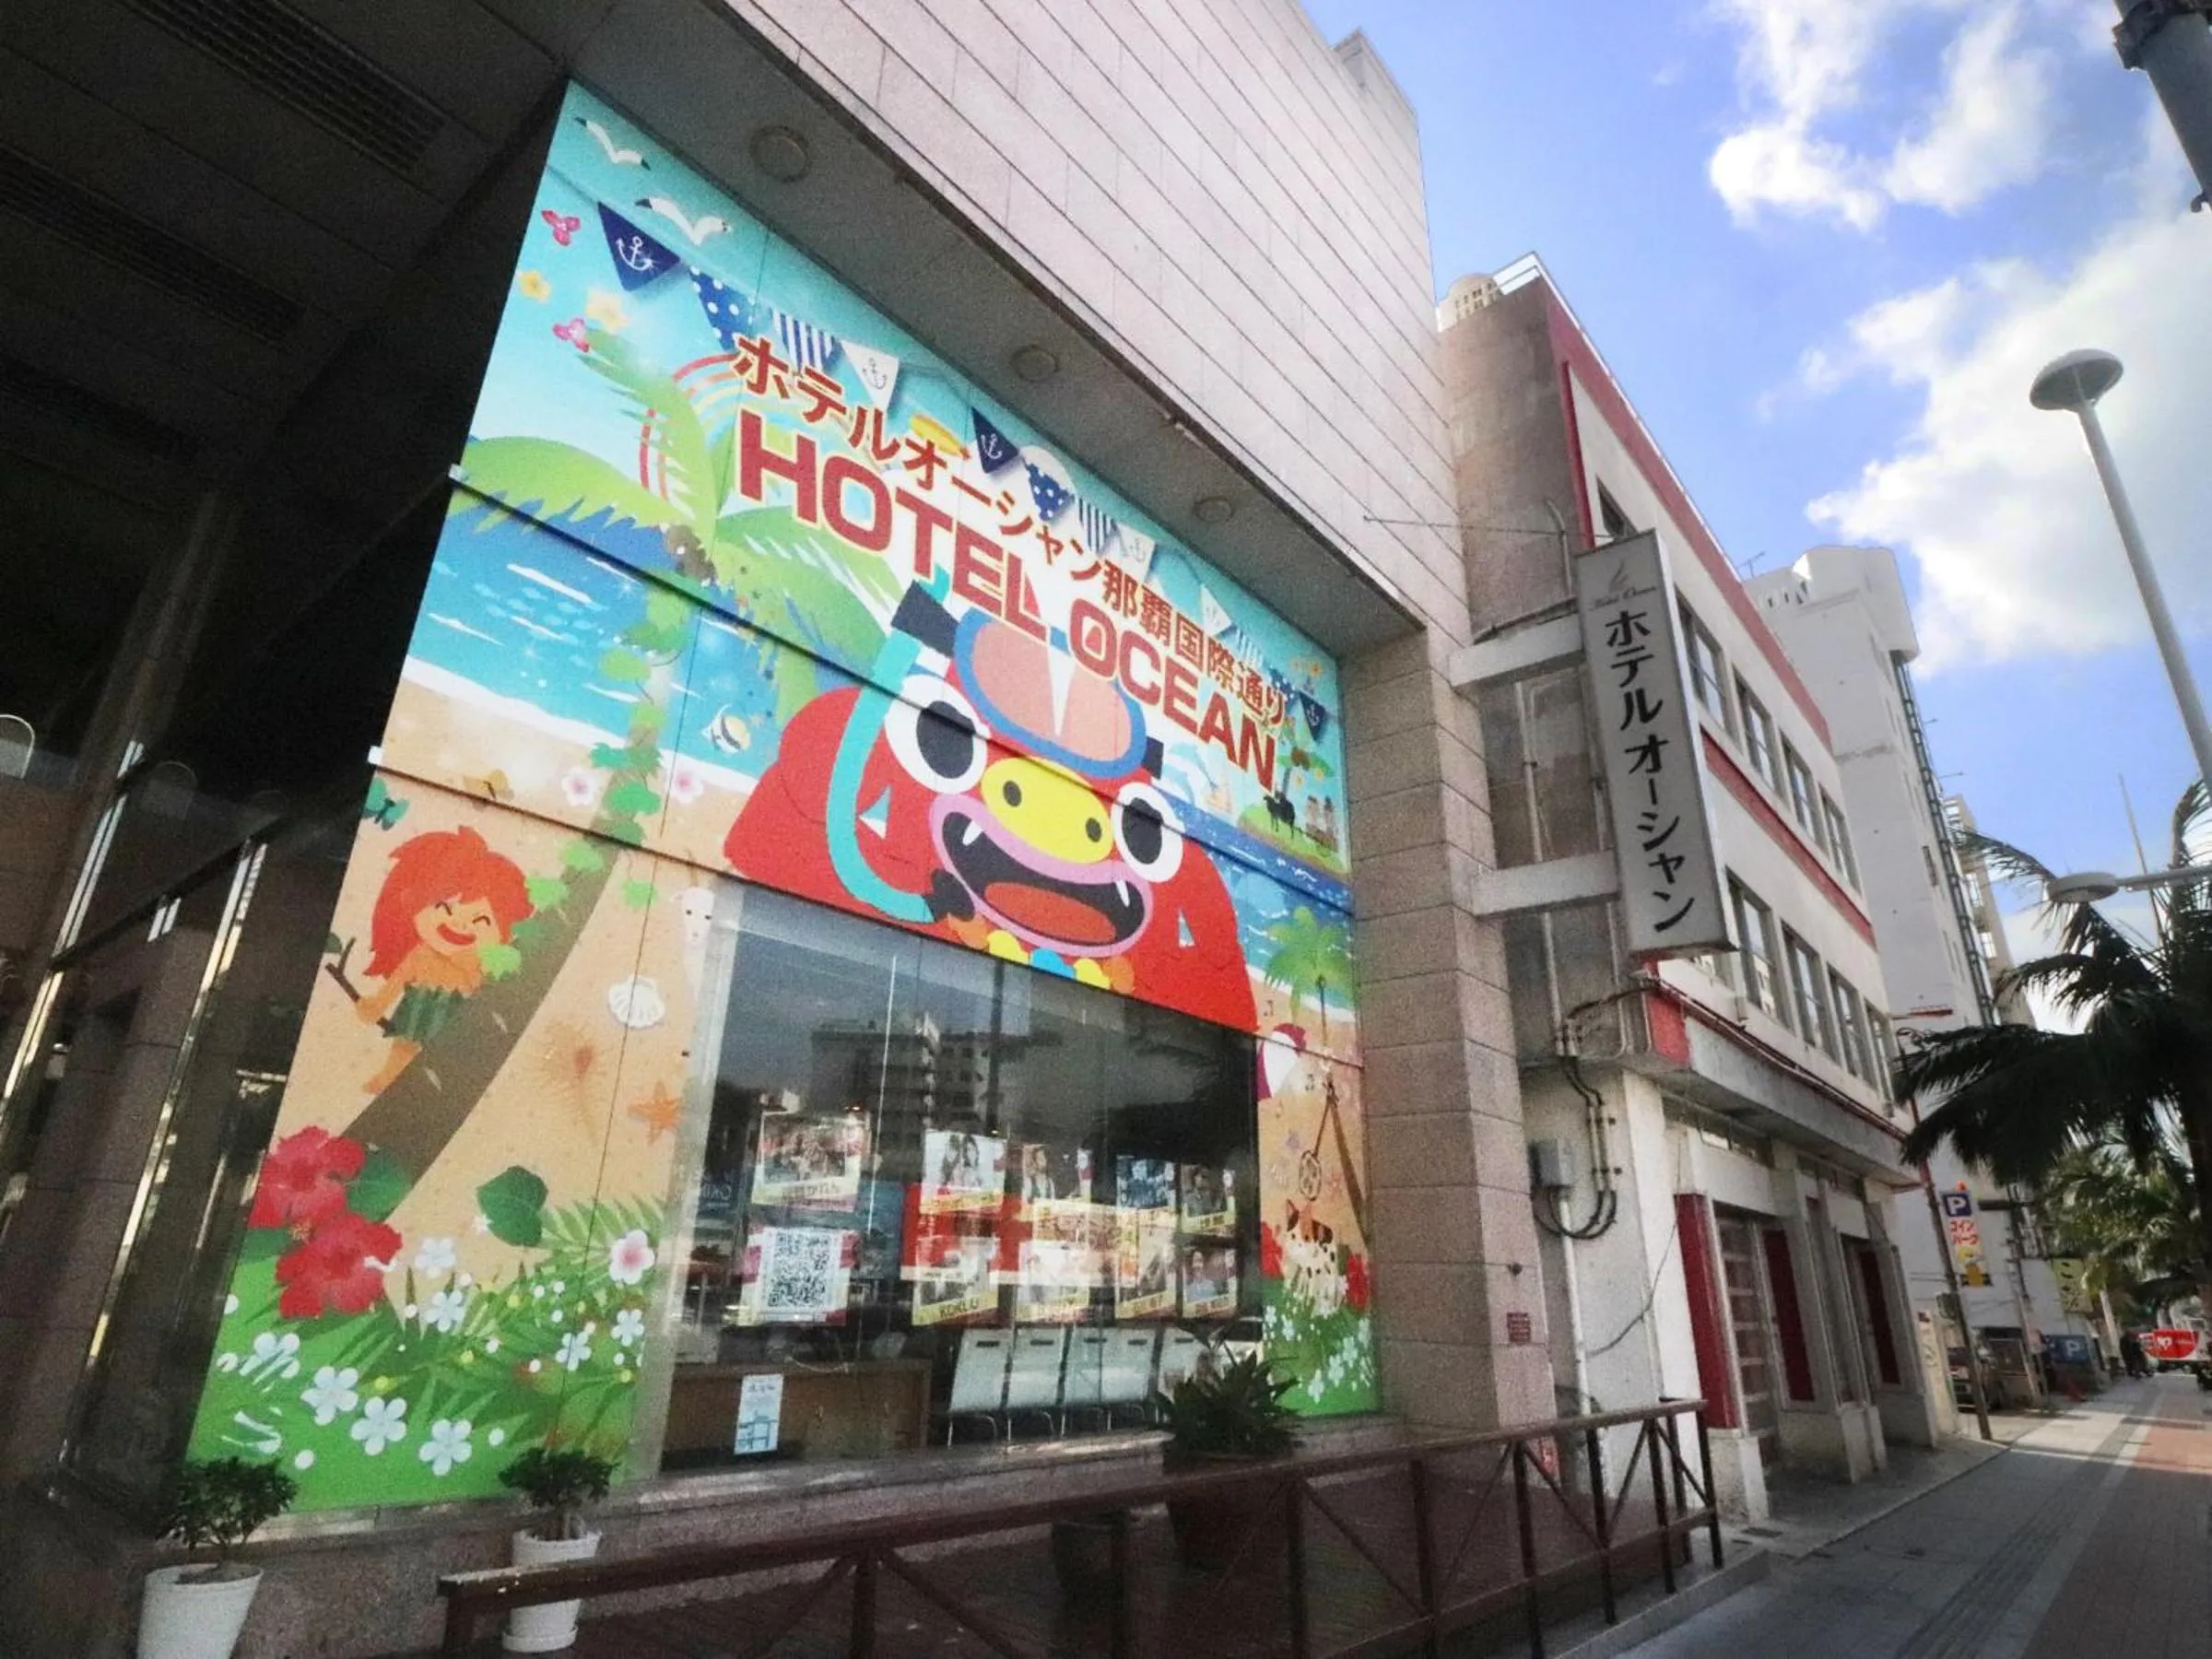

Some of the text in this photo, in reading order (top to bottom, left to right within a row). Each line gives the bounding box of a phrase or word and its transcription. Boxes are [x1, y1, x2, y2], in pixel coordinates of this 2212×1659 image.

[734, 335, 1284, 726] ホテルオーシャン那覇国際通り
[739, 410, 1276, 793] HOTEL OCEAN
[1606, 610, 1695, 932] ホテルオーシャン
[1947, 1196, 1967, 1215] P
